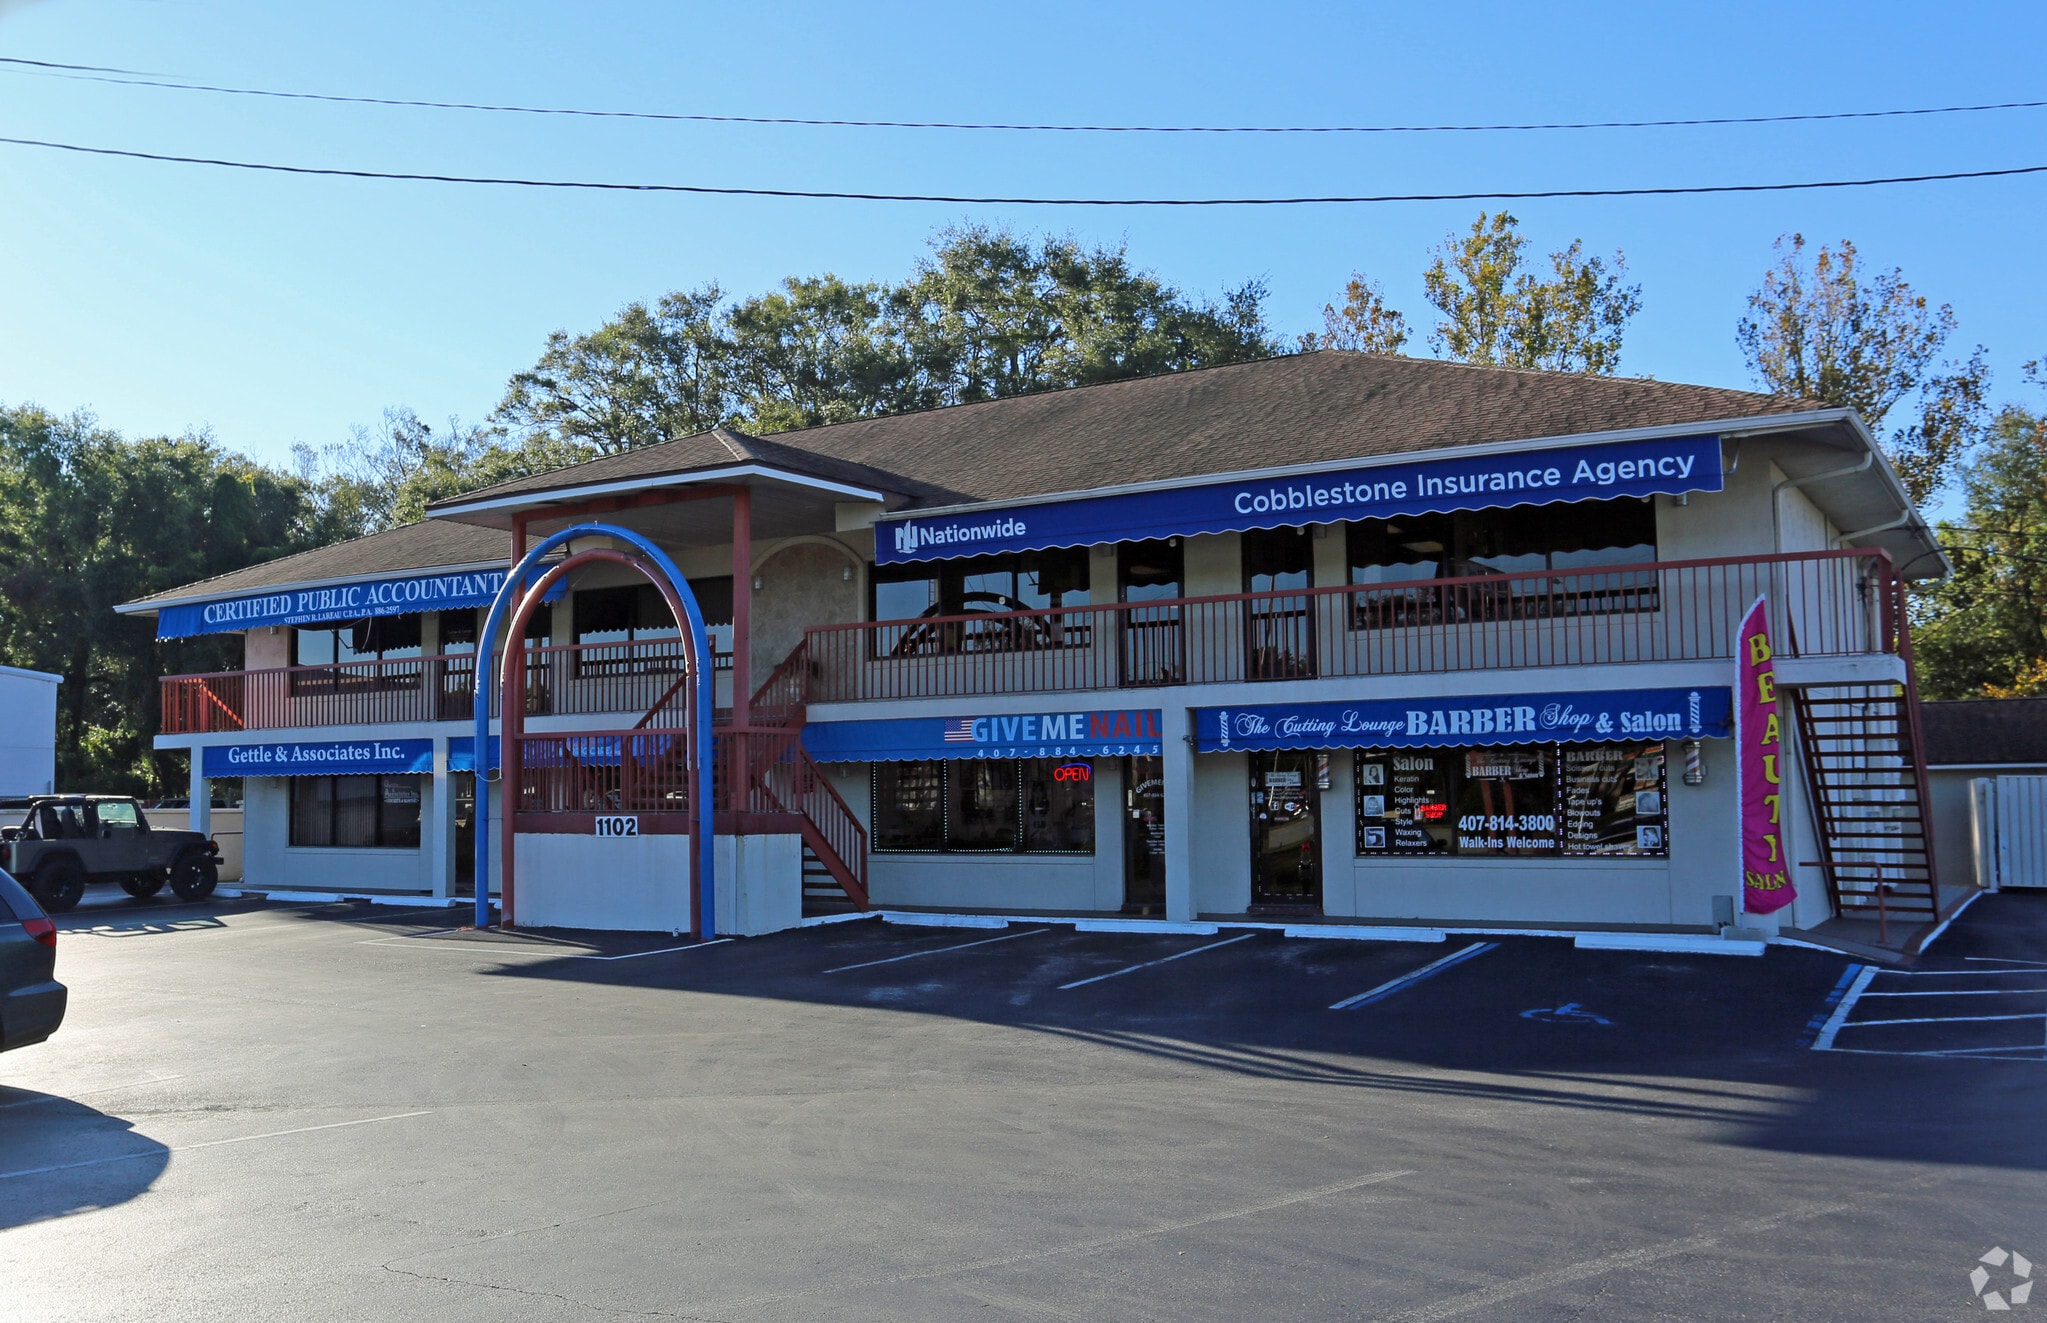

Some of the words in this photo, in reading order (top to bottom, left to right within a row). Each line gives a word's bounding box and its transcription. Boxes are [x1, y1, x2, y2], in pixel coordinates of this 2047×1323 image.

[1233, 473, 1408, 514] Cobblestone
[1417, 464, 1562, 497] Insurance
[1571, 453, 1696, 487] Agency
[920, 517, 1026, 545] Nationwide
[203, 593, 292, 624] CERTIFIED
[297, 586, 362, 613] PUBLIC
[365, 572, 503, 605] ACCOUNTANT
[284, 614, 311, 624] STEPHEN
[311, 613, 318, 621] R.
[318, 611, 342, 620] LABEAU
[374, 605, 400, 615] 886-2597
[1234, 712, 1271, 737] The
[1274, 715, 1337, 739] Cutting
[1341, 709, 1406, 737] Lounge
[1405, 706, 1537, 736] BARBER
[1540, 702, 1595, 734] Shop
[1595, 711, 1614, 734] &
[1620, 711, 1682, 733] Salon
[971, 715, 1037, 743] GIVE
[1041, 714, 1085, 741] ME
[228, 746, 273, 764] Gettle
[275, 746, 288, 762] &
[290, 743, 371, 761] Associates
[374, 743, 405, 759] Inc.
[977, 745, 1159, 758] 407-884-6245
[1565, 750, 1623, 762] BARBER
[1393, 756, 1434, 771] Salon
[1053, 767, 1090, 782] OPEN
[1472, 766, 1511, 776] BARBER
[1601, 775, 1618, 783] cuts
[1394, 797, 1430, 805] Highlights
[1567, 798, 1586, 806] Tape
[1586, 798, 1603, 806] up's
[1394, 807, 1412, 815] Cuts
[596, 817, 637, 836] 1102
[1458, 815, 1556, 831] 407-814-3800
[1567, 820, 1594, 829] Edging
[1395, 829, 1422, 837] Waxing
[1567, 831, 1598, 840] Designs
[1395, 839, 1428, 847] Relaxers
[1459, 836, 1504, 848] Walk-Ins
[1506, 836, 1555, 848] Welcome
